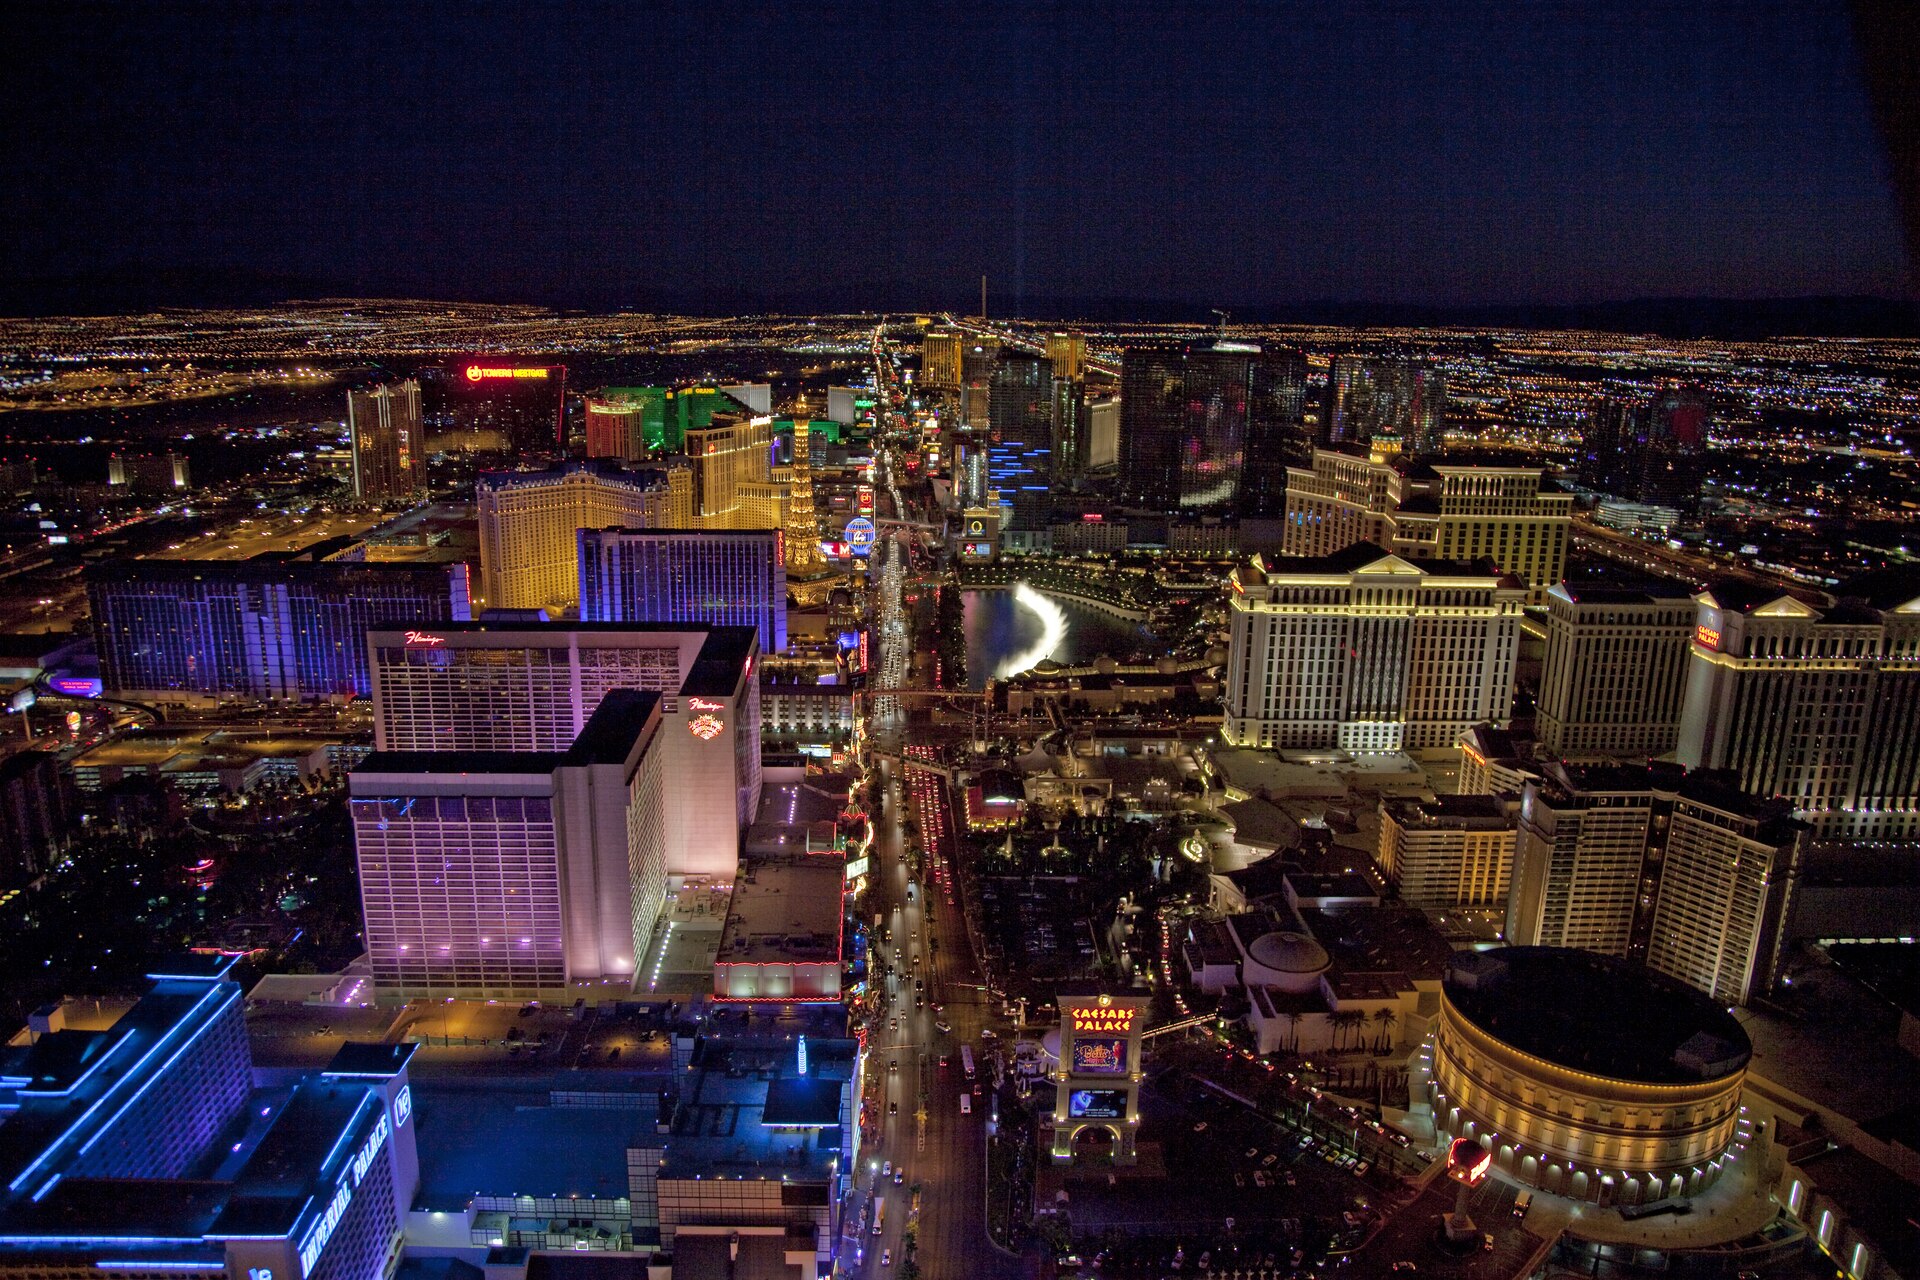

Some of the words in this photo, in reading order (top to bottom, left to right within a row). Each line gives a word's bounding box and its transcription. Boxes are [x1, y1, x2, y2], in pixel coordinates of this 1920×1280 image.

[482, 369, 512, 377] TOWERS
[513, 369, 548, 377] WESTGATE
[404, 631, 445, 645] Flamingo
[1698, 625, 1720, 640] CAESARS
[1698, 632, 1718, 647] PALACE
[689, 697, 724, 711] Flamingo
[1072, 1008, 1134, 1019] CAESARS
[1075, 1020, 1130, 1031] PALACE
[300, 1181, 351, 1280] IMPERIAL
[352, 1114, 388, 1188] PALACE
